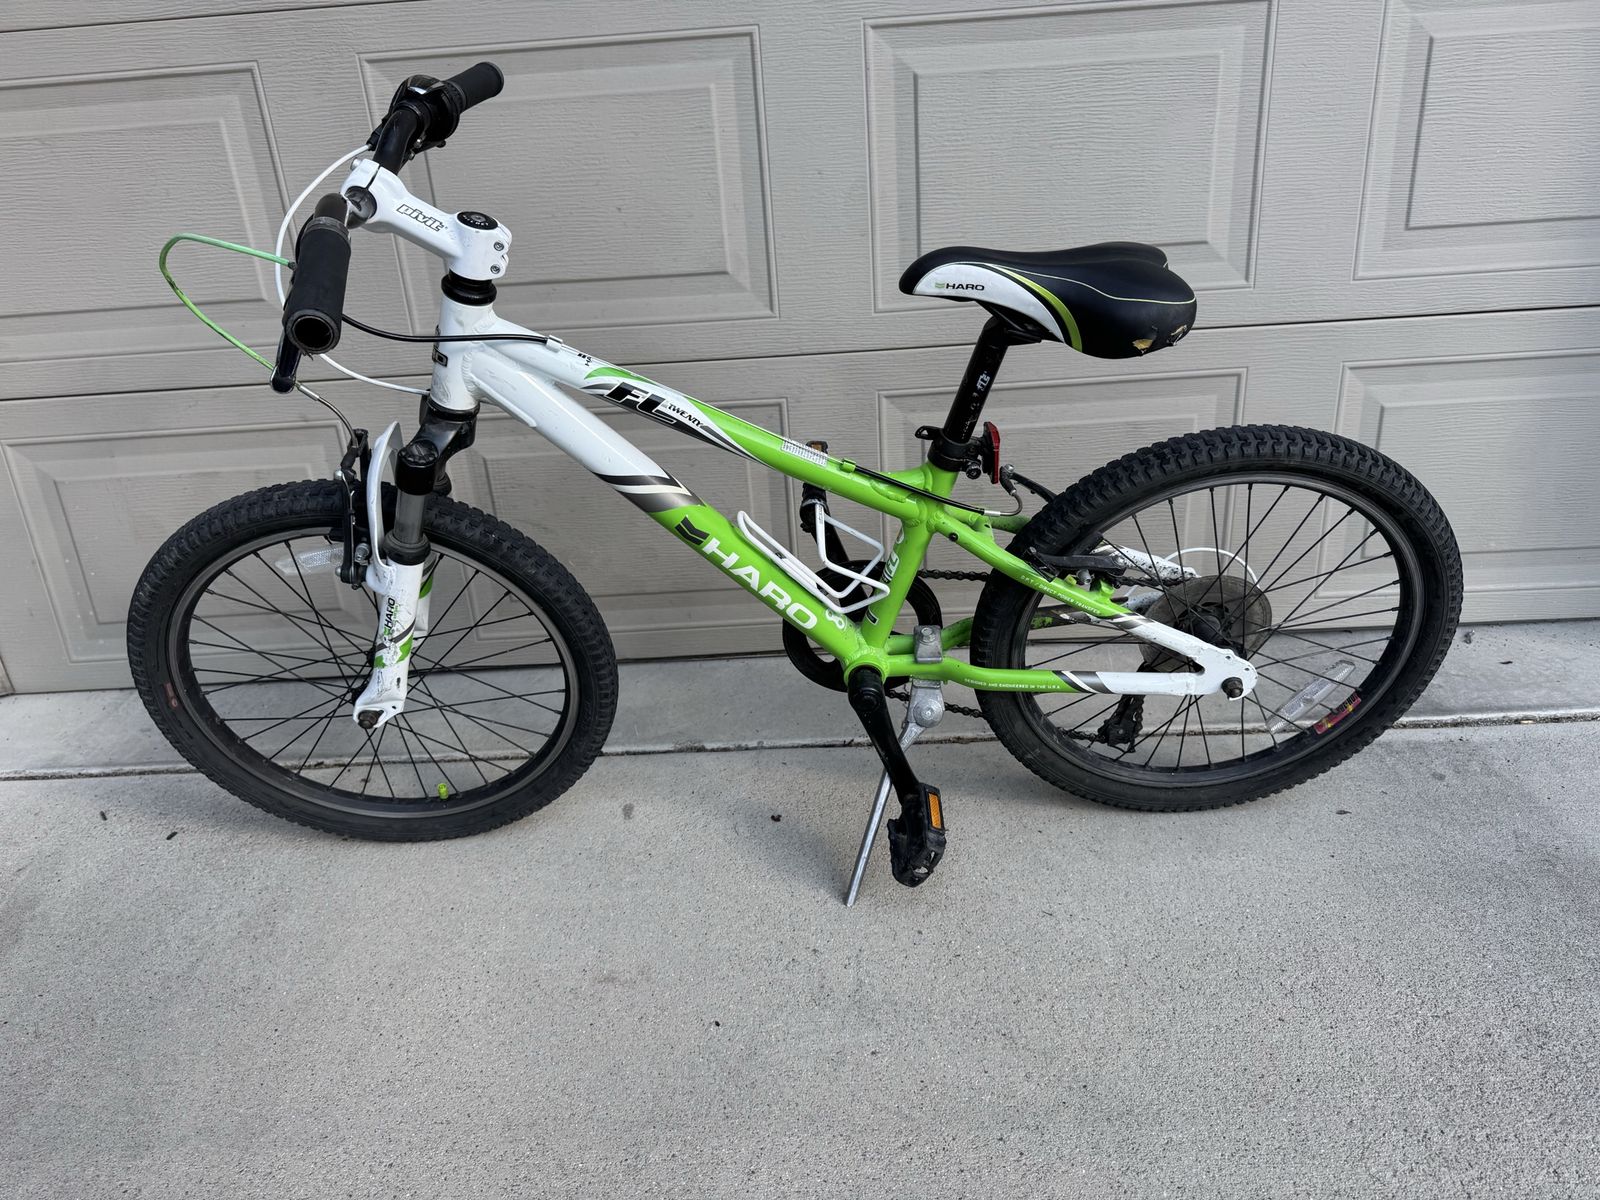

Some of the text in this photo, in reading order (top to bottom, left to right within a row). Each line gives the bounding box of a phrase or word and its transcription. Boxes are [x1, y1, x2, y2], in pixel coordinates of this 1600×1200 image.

[945, 283, 985, 291] HARO
[603, 381, 702, 427] FL TWENTY
[702, 537, 818, 630] HARO
[384, 597, 395, 629] HARO
